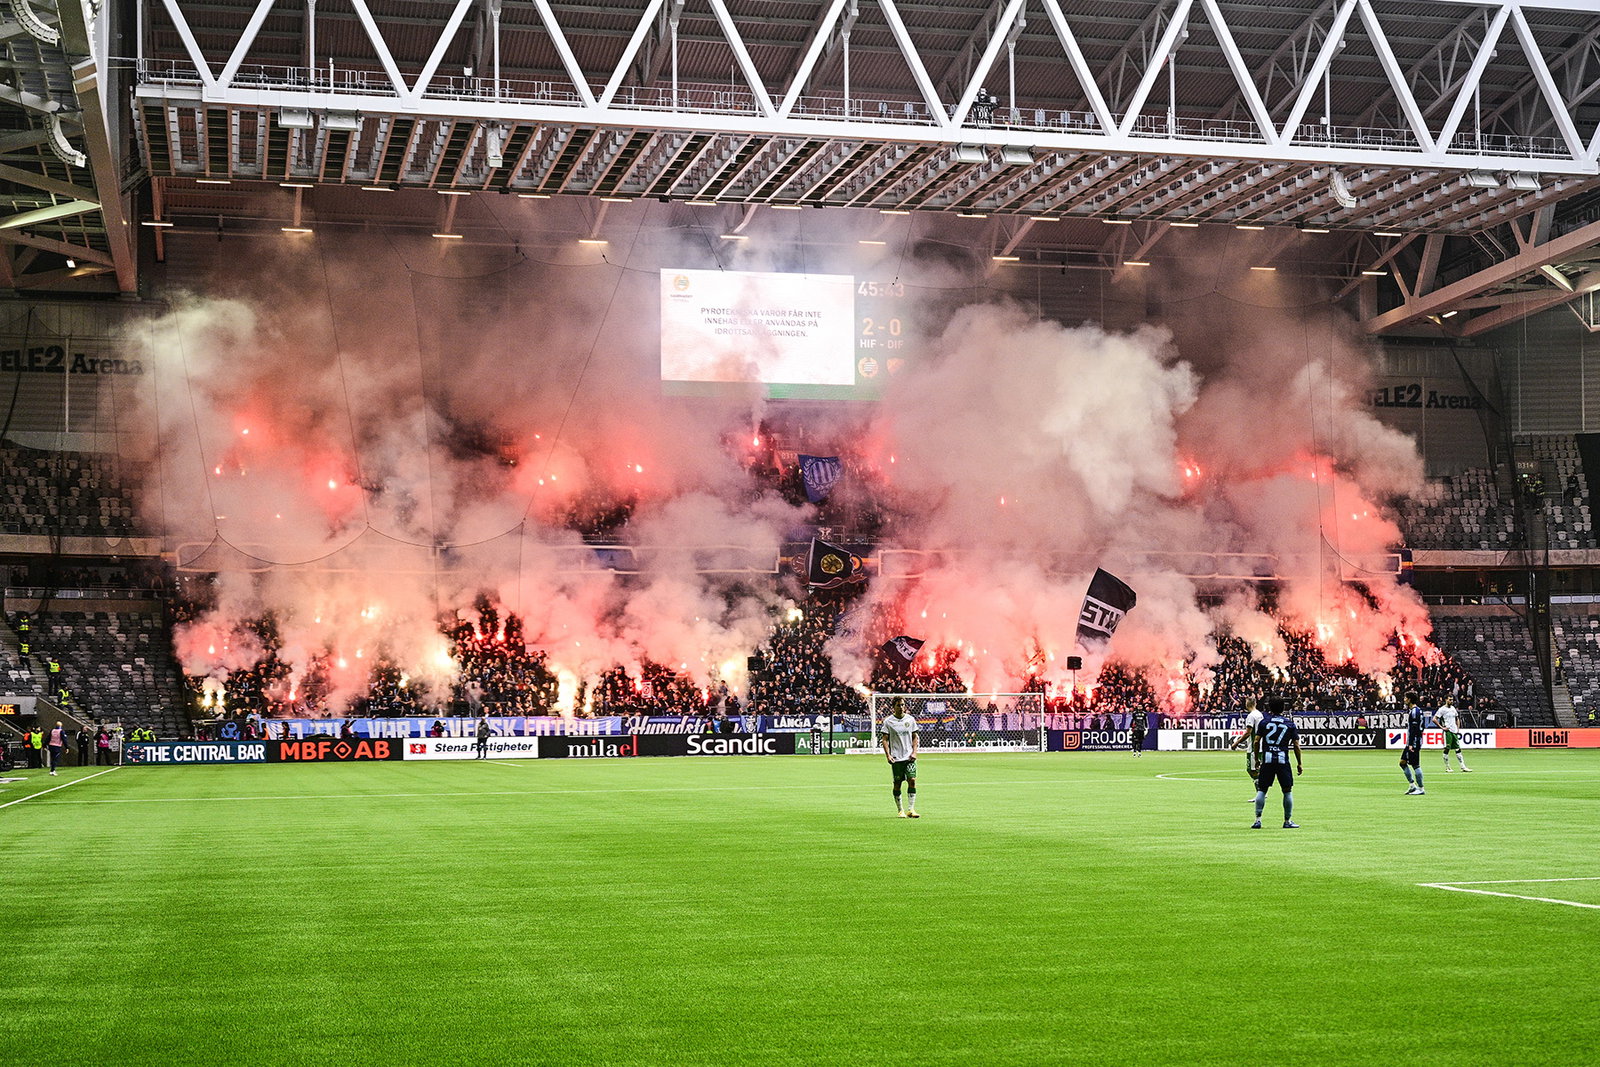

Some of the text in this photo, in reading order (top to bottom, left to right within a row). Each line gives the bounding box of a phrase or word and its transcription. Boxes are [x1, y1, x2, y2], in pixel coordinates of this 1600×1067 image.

[760, 309, 786, 317] VAROR
[788, 308, 803, 318] FÅR
[704, 317, 738, 325] INNEHAS
[808, 319, 819, 328] PÅ
[862, 317, 874, 336] 2
[889, 318, 901, 336] 0
[860, 339, 877, 348] HIF
[887, 340, 904, 349] DIF
[0, 345, 144, 375] ELE2 Arena
[367, 720, 411, 738] VAR
[773, 716, 811, 728] LÅNGA
[1204, 718, 1228, 729] MOT
[1265, 722, 1289, 745] 27
[1288, 732, 1377, 746] ETODGOLV
[280, 740, 390, 760] MBF AB
[434, 742, 468, 752] Stena
[567, 735, 639, 757] milael
[686, 733, 776, 754] Scandic
[143, 744, 265, 761] THE CENTRAL BAR
